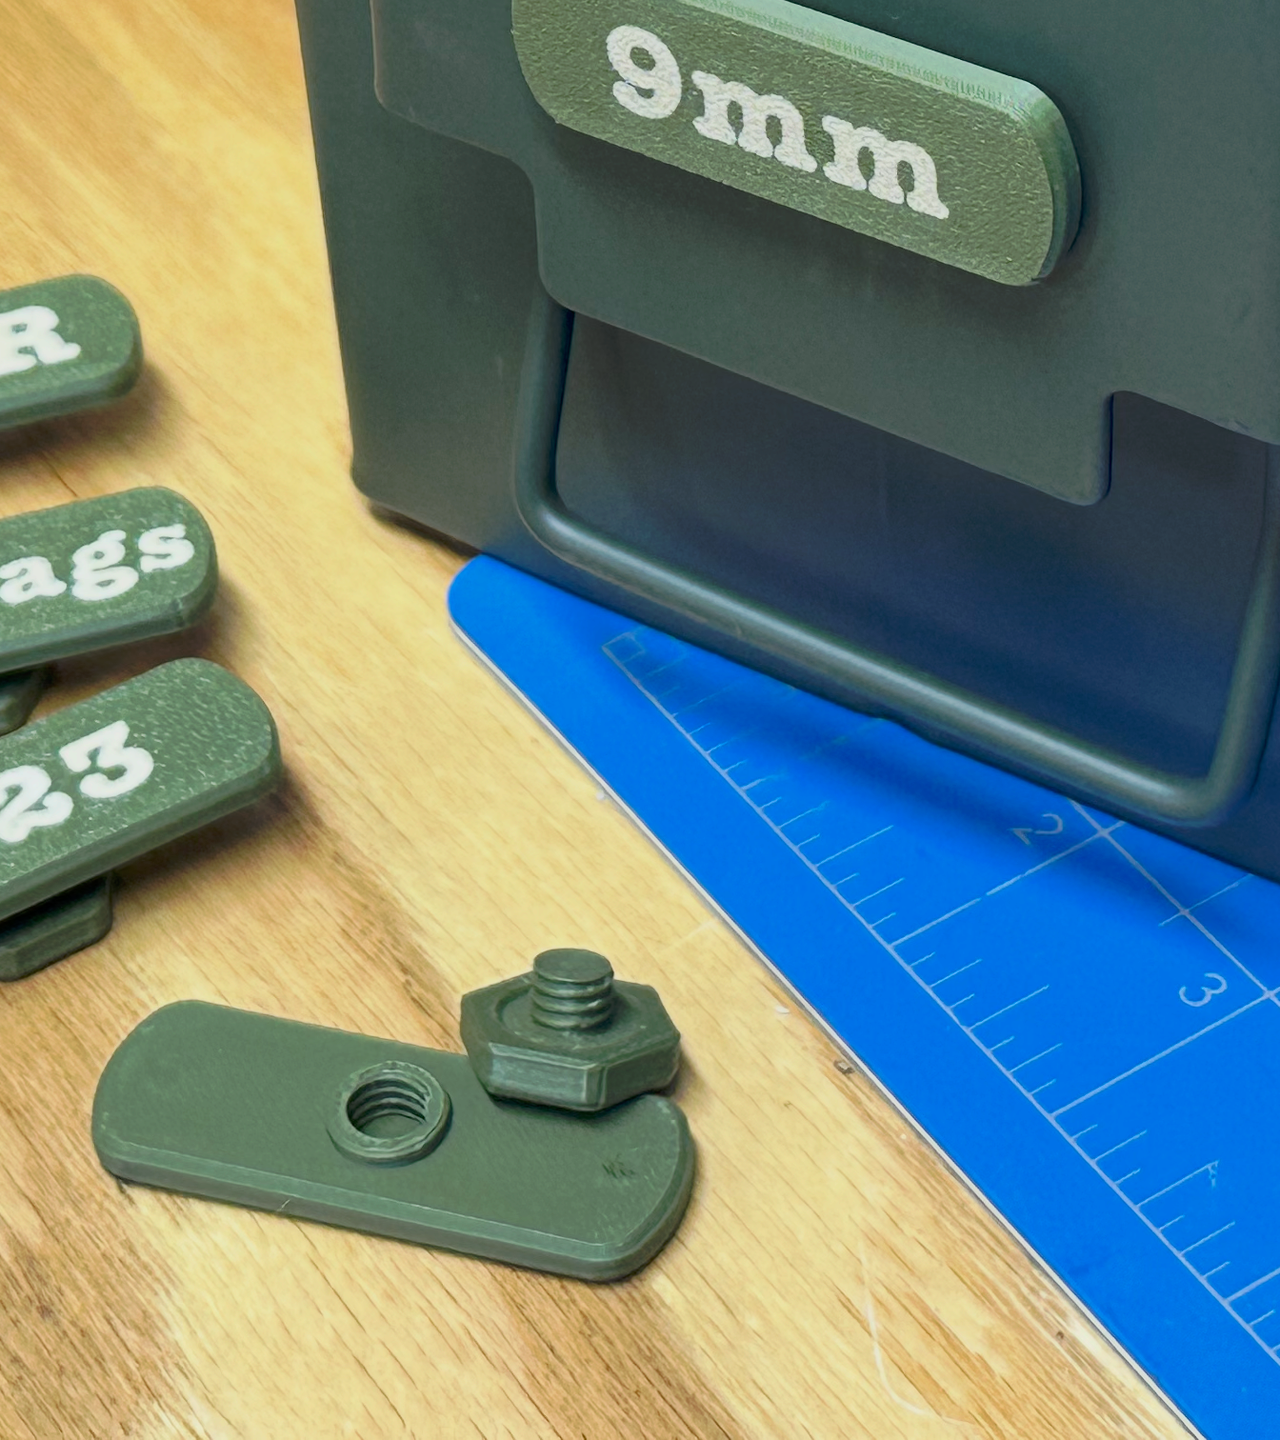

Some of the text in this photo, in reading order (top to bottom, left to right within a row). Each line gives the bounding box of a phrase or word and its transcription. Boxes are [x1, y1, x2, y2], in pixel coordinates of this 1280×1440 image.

[605, 25, 950, 220] 9mm
[1008, 813, 1063, 846] 2
[1178, 972, 1228, 1008] 3
